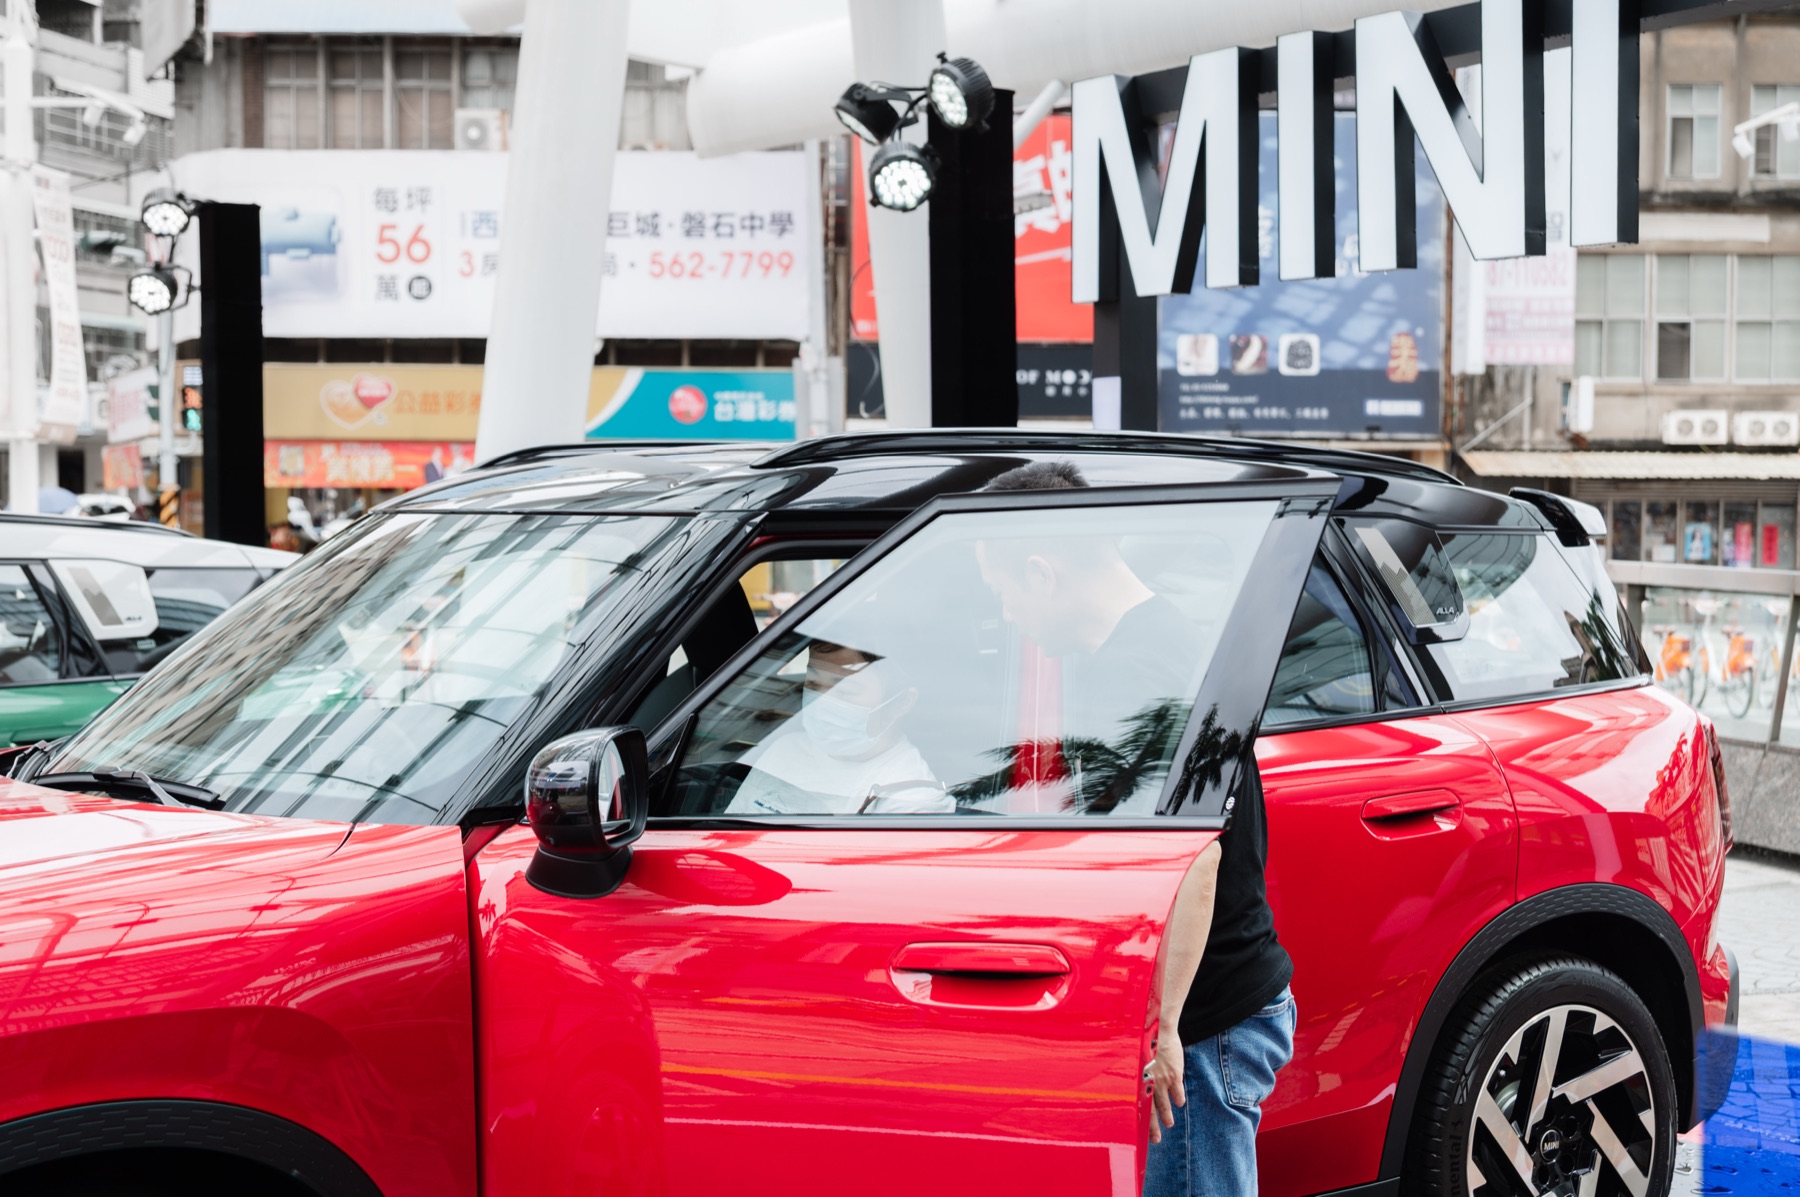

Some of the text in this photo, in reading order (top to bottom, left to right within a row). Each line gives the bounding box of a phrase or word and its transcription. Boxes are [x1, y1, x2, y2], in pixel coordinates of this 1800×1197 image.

[1071, 0, 1638, 304] MINI
[376, 223, 432, 264] 56
[1543, 1140, 1560, 1152] MINI
